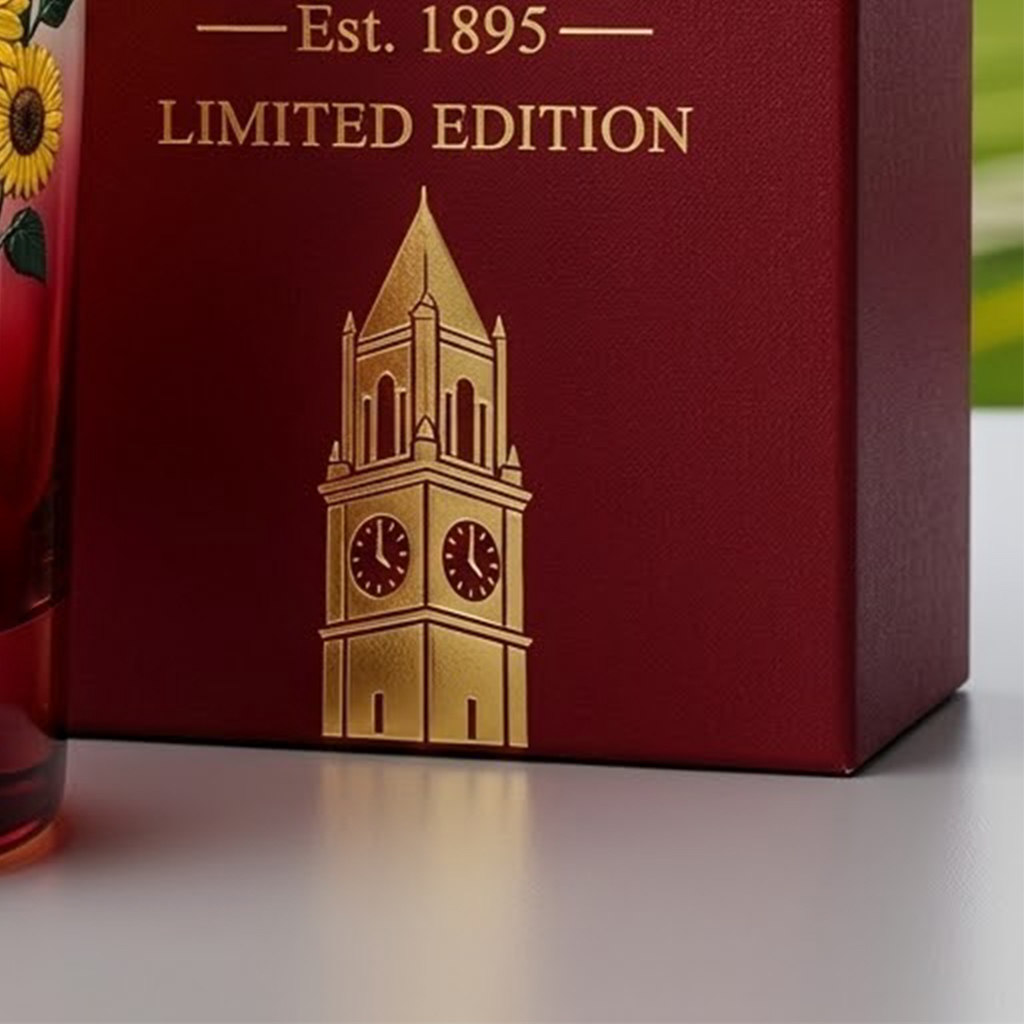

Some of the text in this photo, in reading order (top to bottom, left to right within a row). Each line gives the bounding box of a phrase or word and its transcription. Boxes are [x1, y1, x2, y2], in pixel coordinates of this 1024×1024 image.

[296, 3, 547, 55] Est. 1895
[157, 98, 694, 154] LIMITED EDITION
